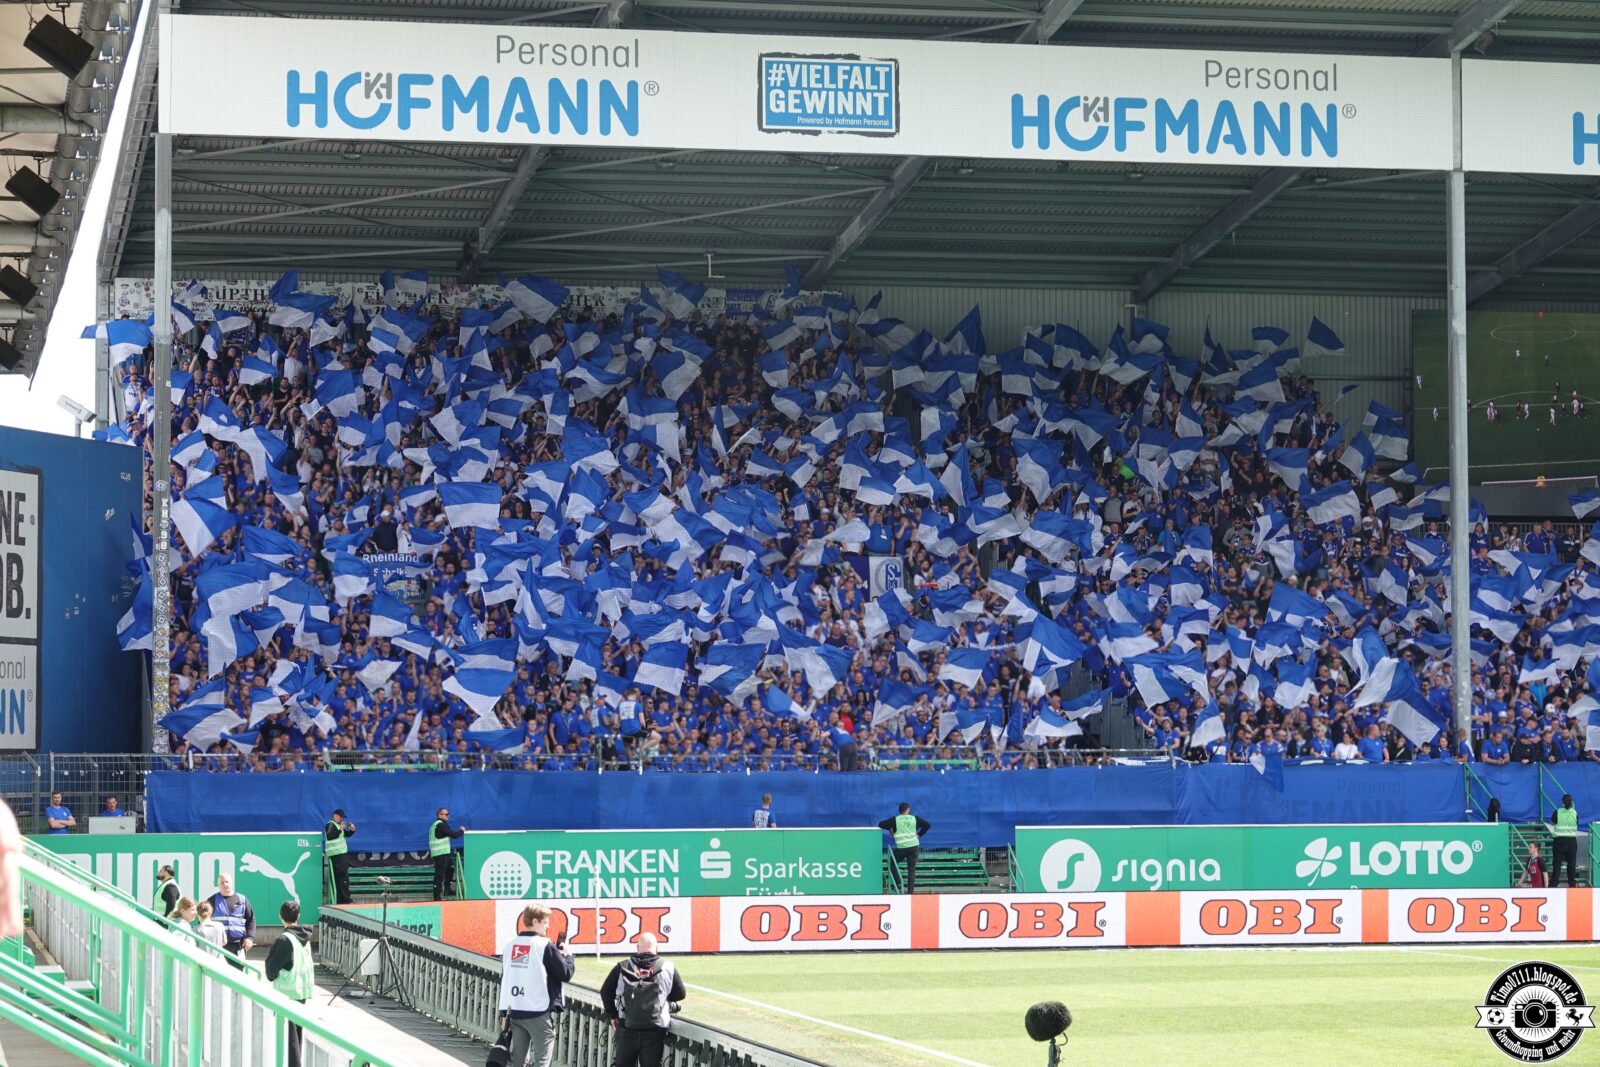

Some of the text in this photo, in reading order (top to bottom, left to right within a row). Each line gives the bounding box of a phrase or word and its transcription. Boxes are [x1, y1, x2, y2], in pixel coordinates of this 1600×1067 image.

[496, 34, 640, 68] Personal
[767, 63, 889, 90] #VIELFALT
[1204, 60, 1338, 91] Personal
[769, 88, 889, 116] GEWINNT
[797, 116, 889, 126] Powered by Hofmann Personal
[535, 849, 679, 875] FRANKEN
[744, 857, 863, 884] Sparkasse
[1112, 858, 1221, 891] signia
